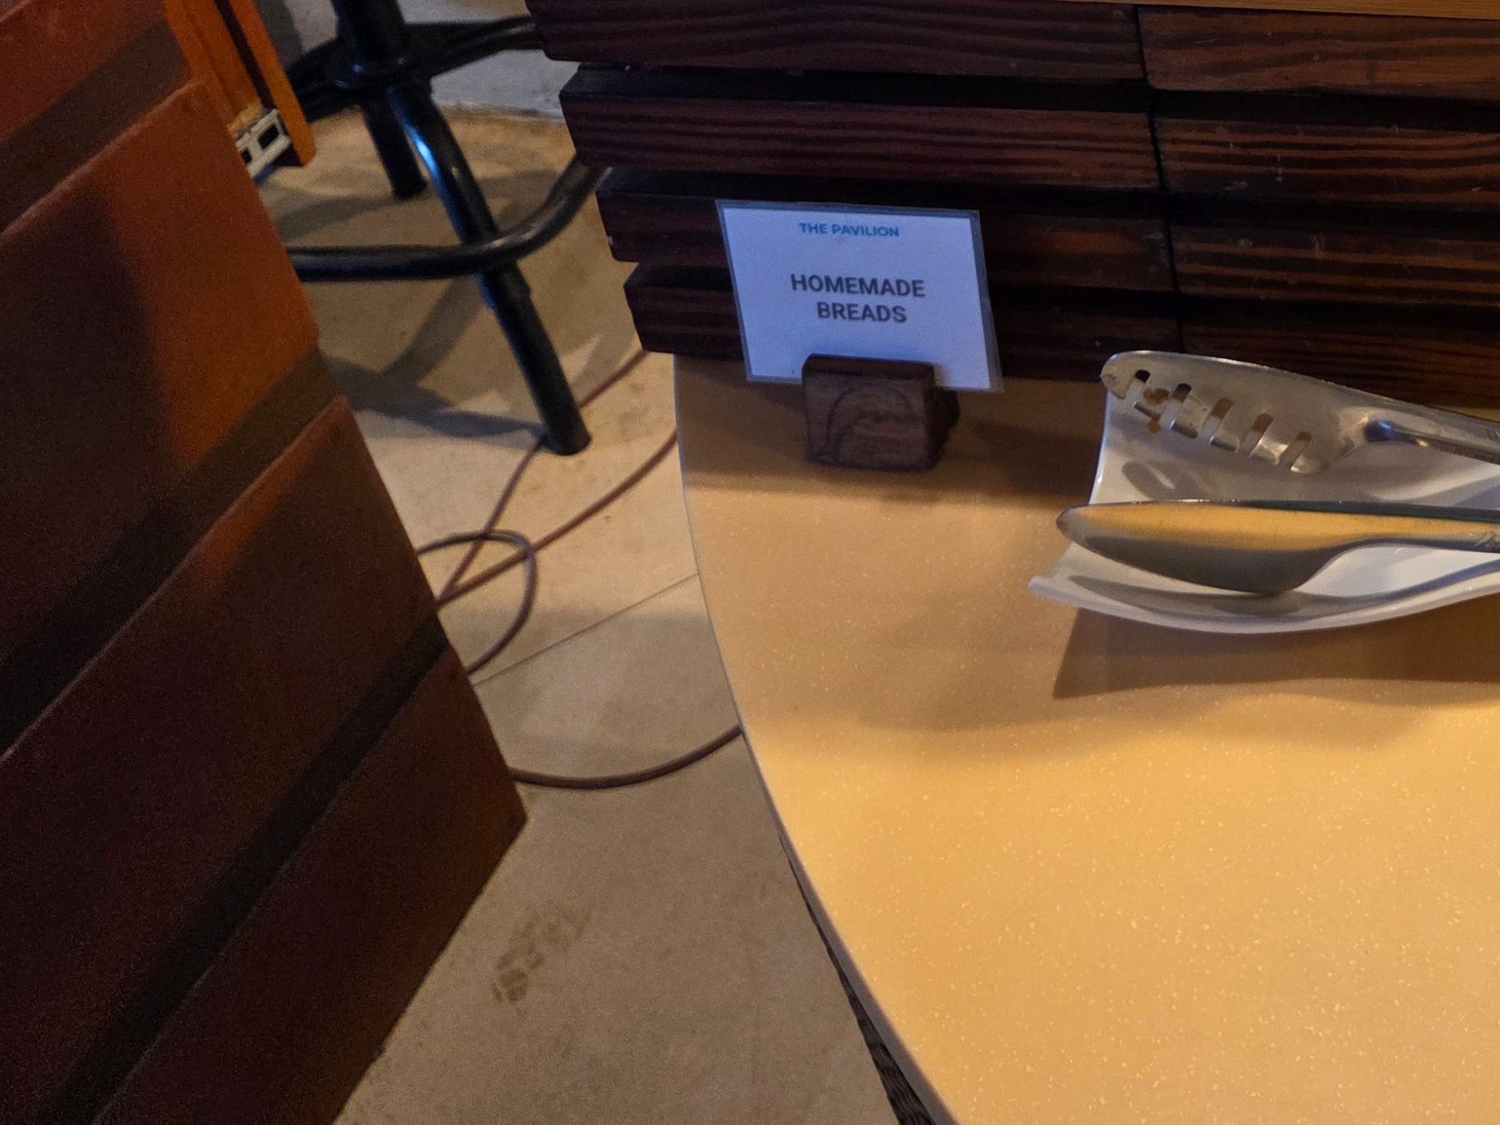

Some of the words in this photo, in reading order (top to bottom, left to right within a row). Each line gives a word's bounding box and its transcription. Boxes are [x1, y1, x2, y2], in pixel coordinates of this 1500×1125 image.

[799, 222, 829, 235] THE
[831, 223, 900, 237] PAVILION
[790, 274, 926, 297] HOMEMADE
[817, 301, 907, 323] BREADS
